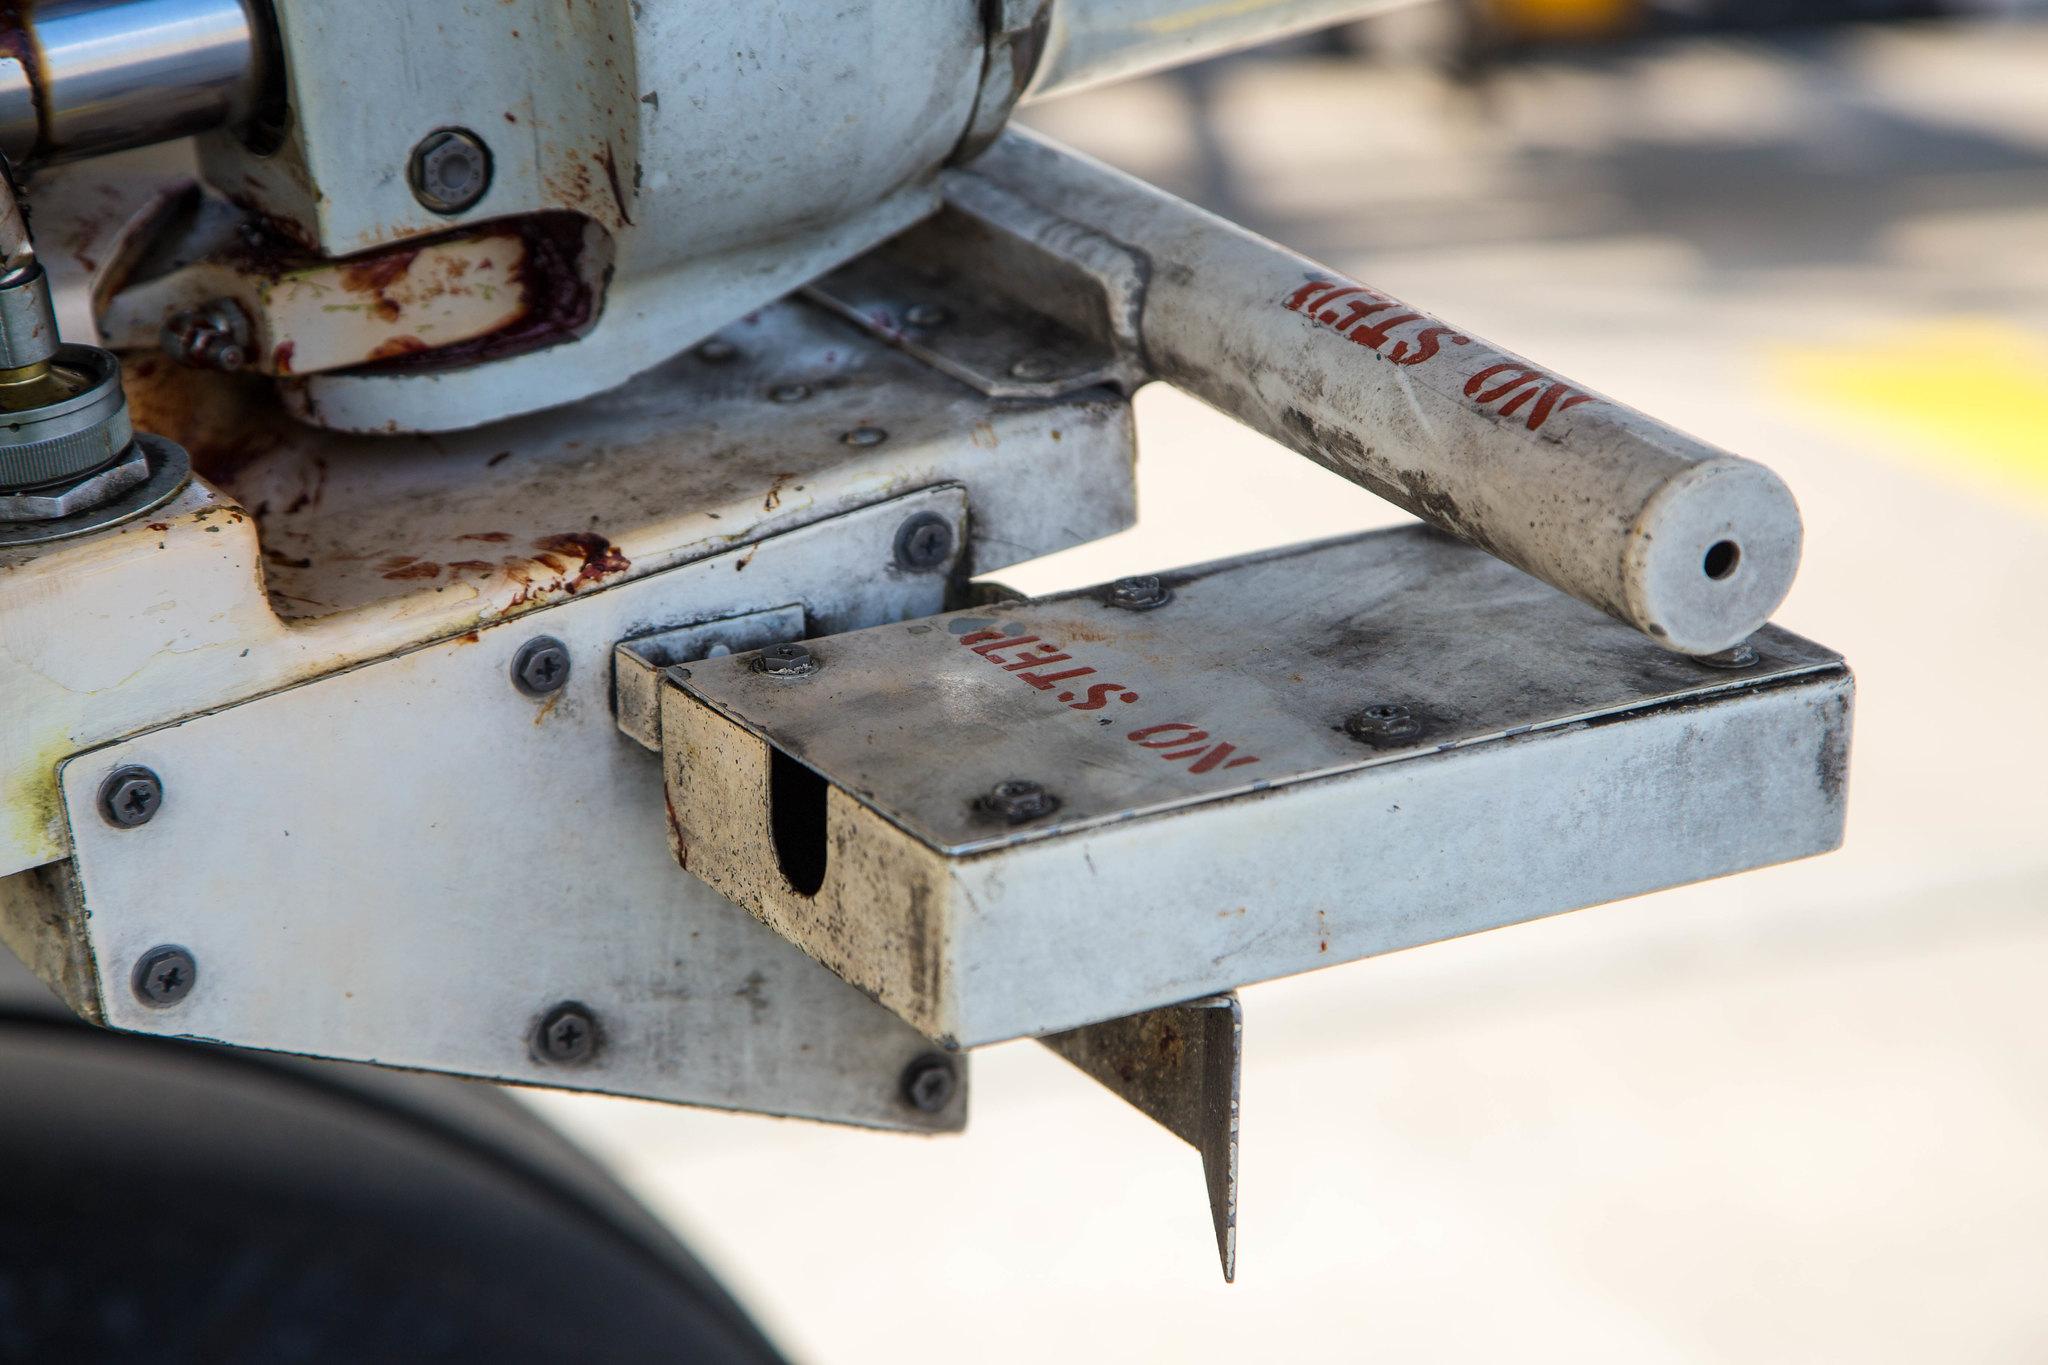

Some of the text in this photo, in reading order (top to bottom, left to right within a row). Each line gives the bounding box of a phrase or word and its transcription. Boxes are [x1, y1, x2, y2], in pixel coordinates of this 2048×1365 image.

[1285, 281, 1598, 431] NO STEP
[960, 631, 1260, 775] NO STEP
